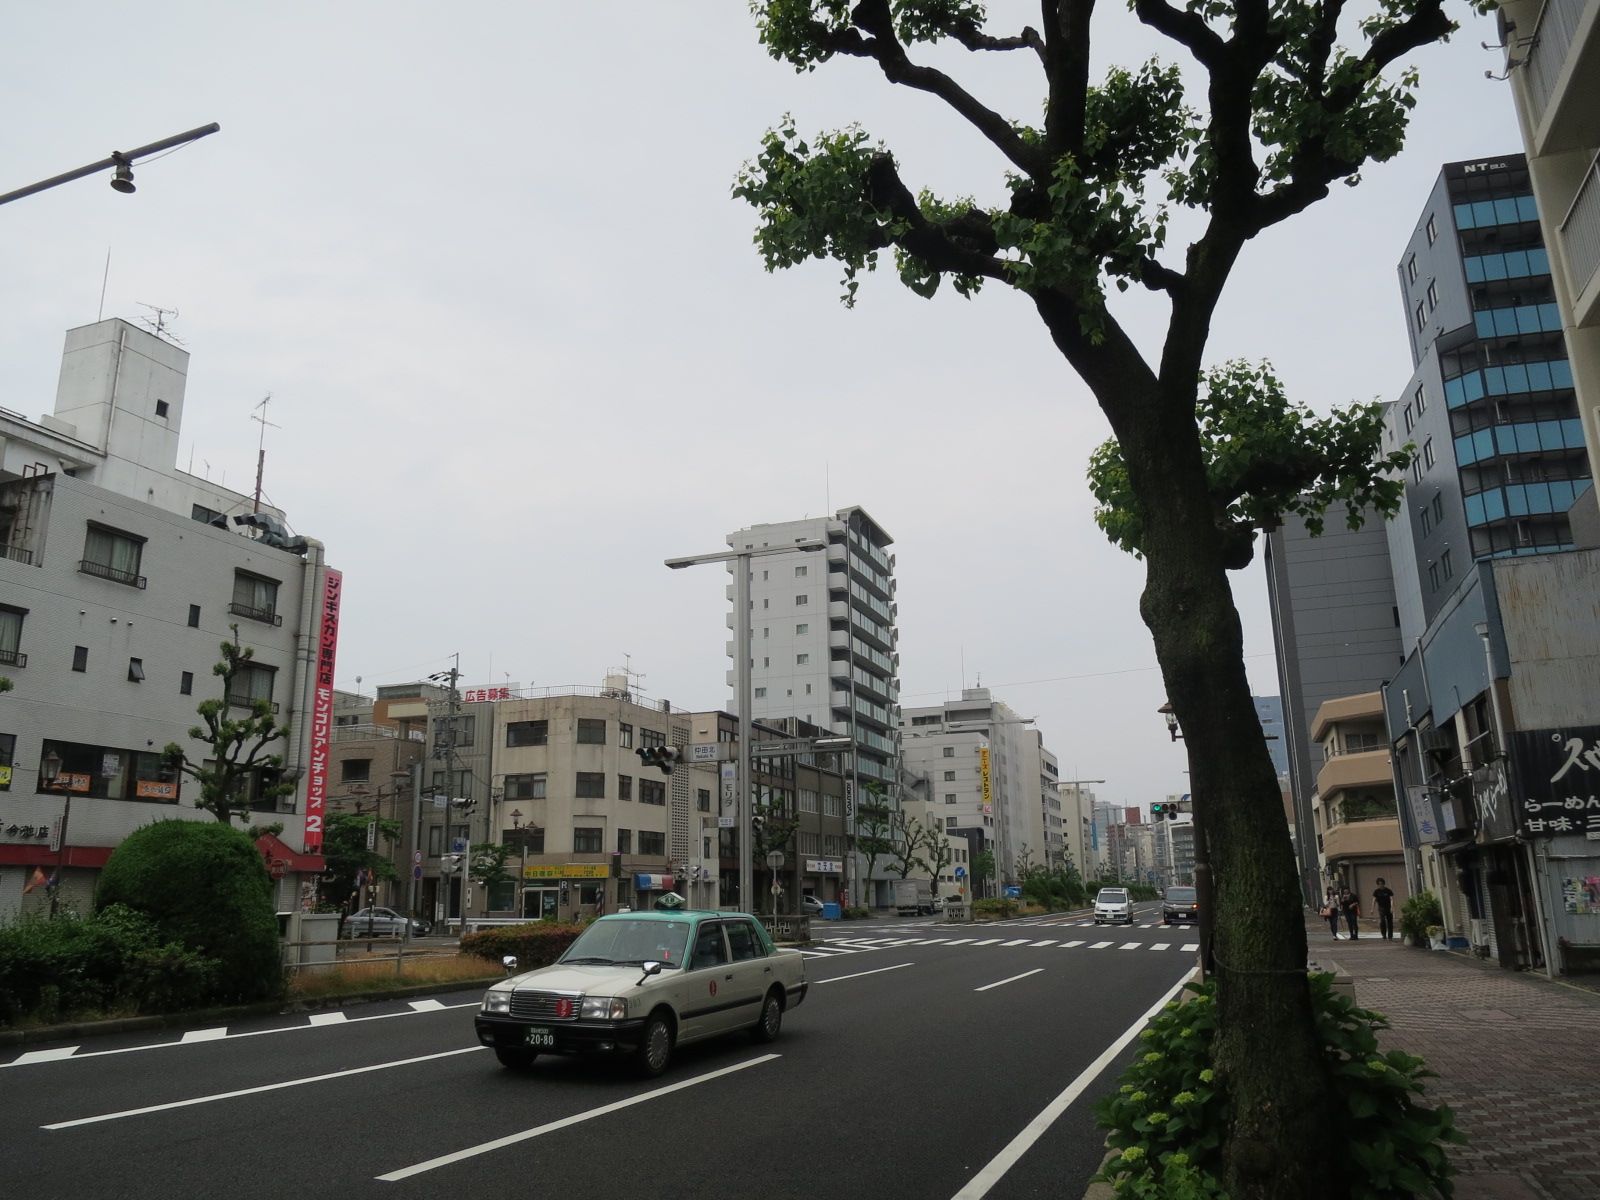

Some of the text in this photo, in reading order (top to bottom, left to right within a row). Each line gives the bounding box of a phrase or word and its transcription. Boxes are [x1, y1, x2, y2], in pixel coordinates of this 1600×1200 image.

[465, 687, 510, 702] 広告募集
[695, 746, 716, 754] 仲田北
[725, 783, 733, 807] モリタ
[1524, 795, 1600, 812] らーめん
[306, 815, 322, 832] 2
